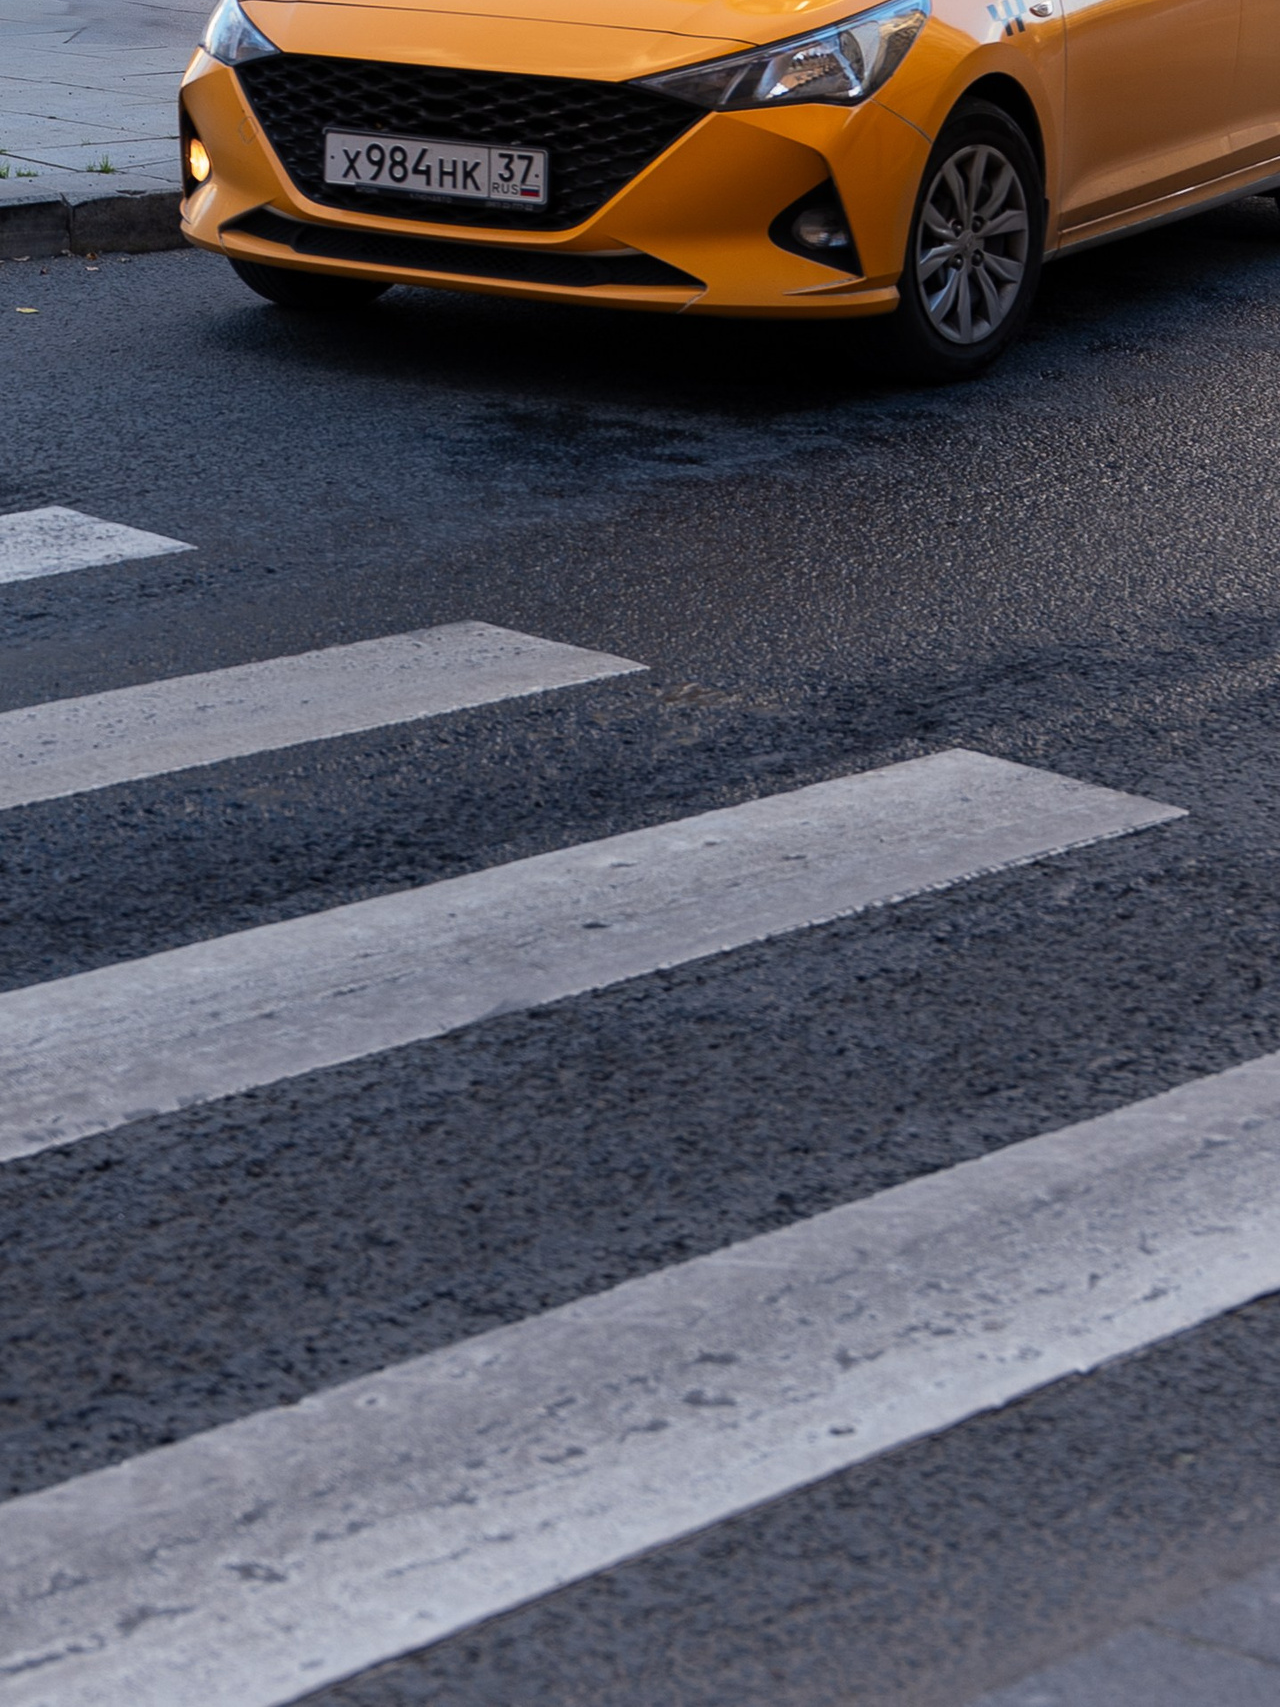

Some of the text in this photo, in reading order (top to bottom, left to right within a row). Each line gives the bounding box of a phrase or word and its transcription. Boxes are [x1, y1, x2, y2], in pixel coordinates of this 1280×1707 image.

[342, 143, 534, 191] Х984НК 37
[492, 183, 519, 195] RUS
